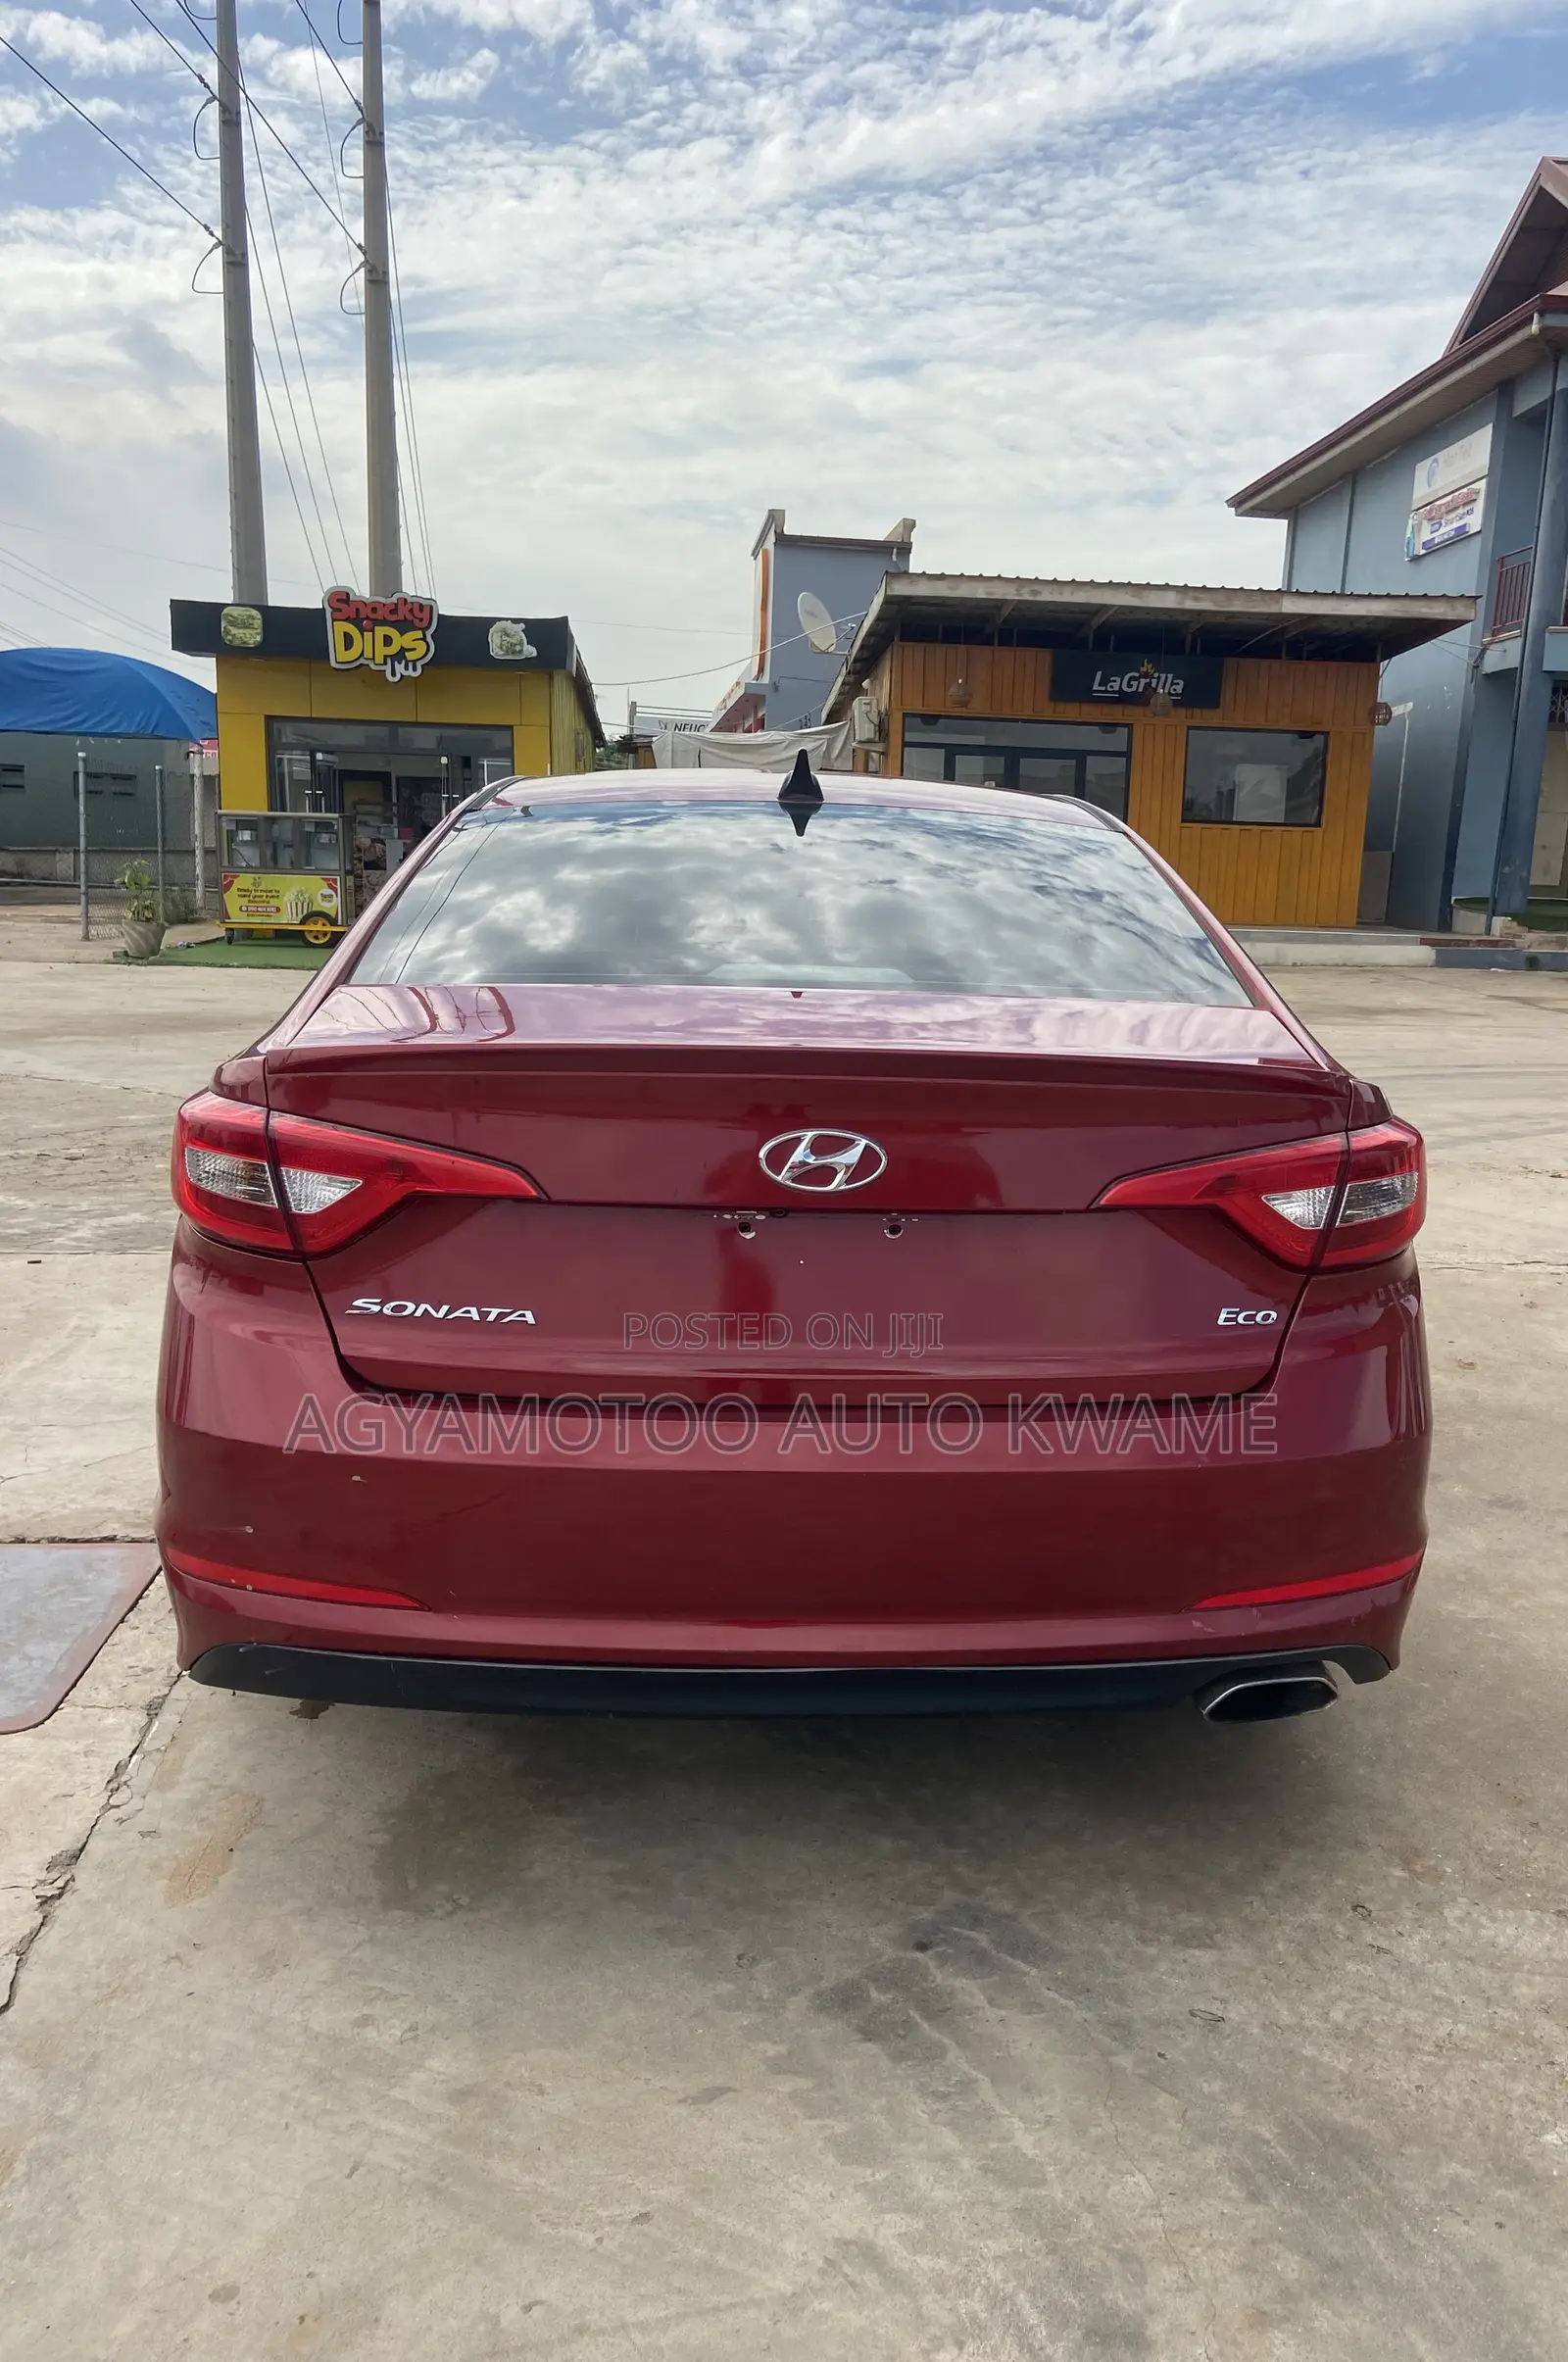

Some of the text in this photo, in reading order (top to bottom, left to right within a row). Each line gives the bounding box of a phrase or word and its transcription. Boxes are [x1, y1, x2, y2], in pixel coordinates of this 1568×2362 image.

[328, 590, 430, 628] Snacky
[333, 620, 427, 664] Dips
[1092, 670, 1185, 694] LaGrilla
[344, 1298, 537, 1325] SONATA
